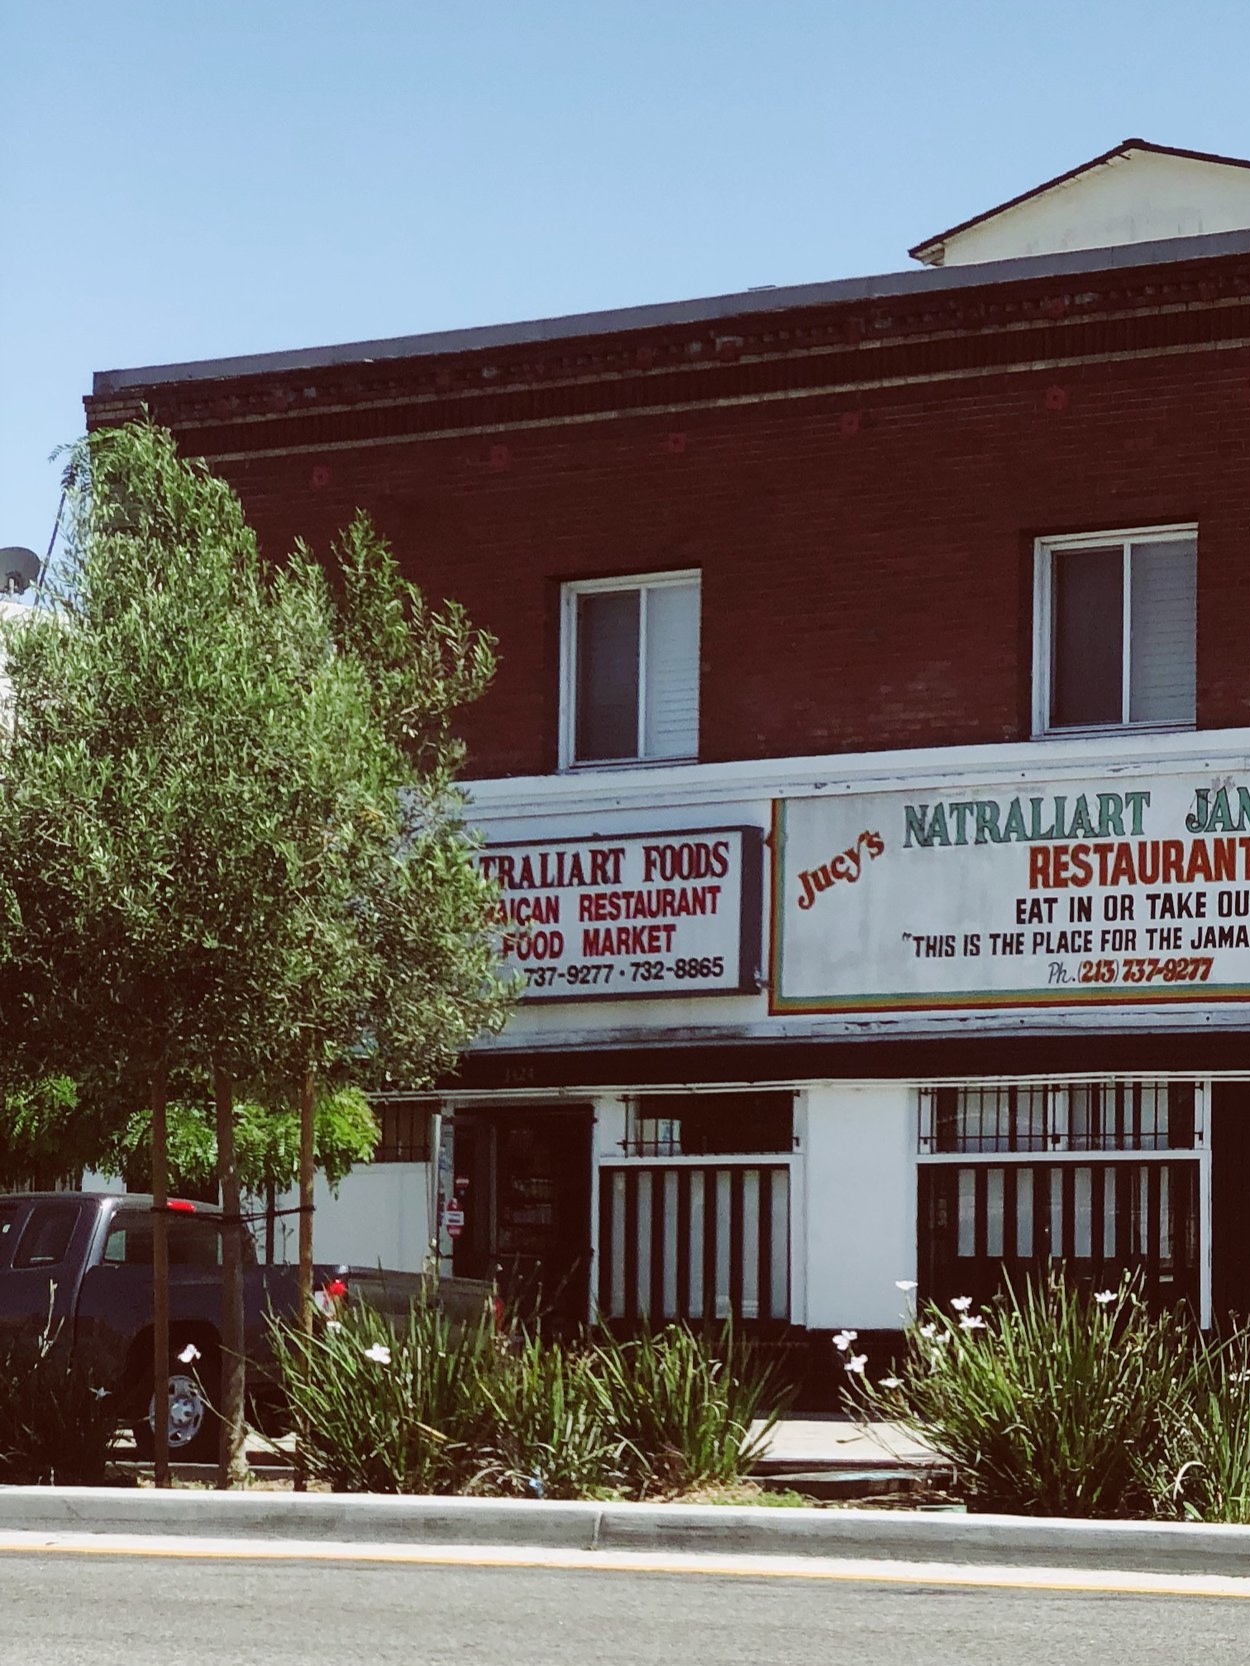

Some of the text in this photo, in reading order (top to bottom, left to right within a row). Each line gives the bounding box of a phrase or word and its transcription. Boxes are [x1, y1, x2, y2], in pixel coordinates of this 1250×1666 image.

[903, 791, 1151, 849] NATRALIART
[468, 841, 730, 890] TRALIART FOODS
[797, 830, 886, 910] Jucy's
[578, 885, 722, 923] RESTAURANT
[1016, 897, 1059, 925] EAT
[1070, 896, 1093, 923] IN
[1104, 894, 1135, 922] OR
[1146, 892, 1207, 921] TAKE
[502, 925, 677, 962] FOOD MARKET
[964, 934, 981, 957] IS
[989, 933, 1025, 956] THE
[1033, 931, 1093, 955] PLACE
[1101, 929, 1137, 953] FOR
[1146, 928, 1183, 951] THE
[630, 956, 724, 982] 732-8865
[1122, 957, 1214, 983] 737-9277
